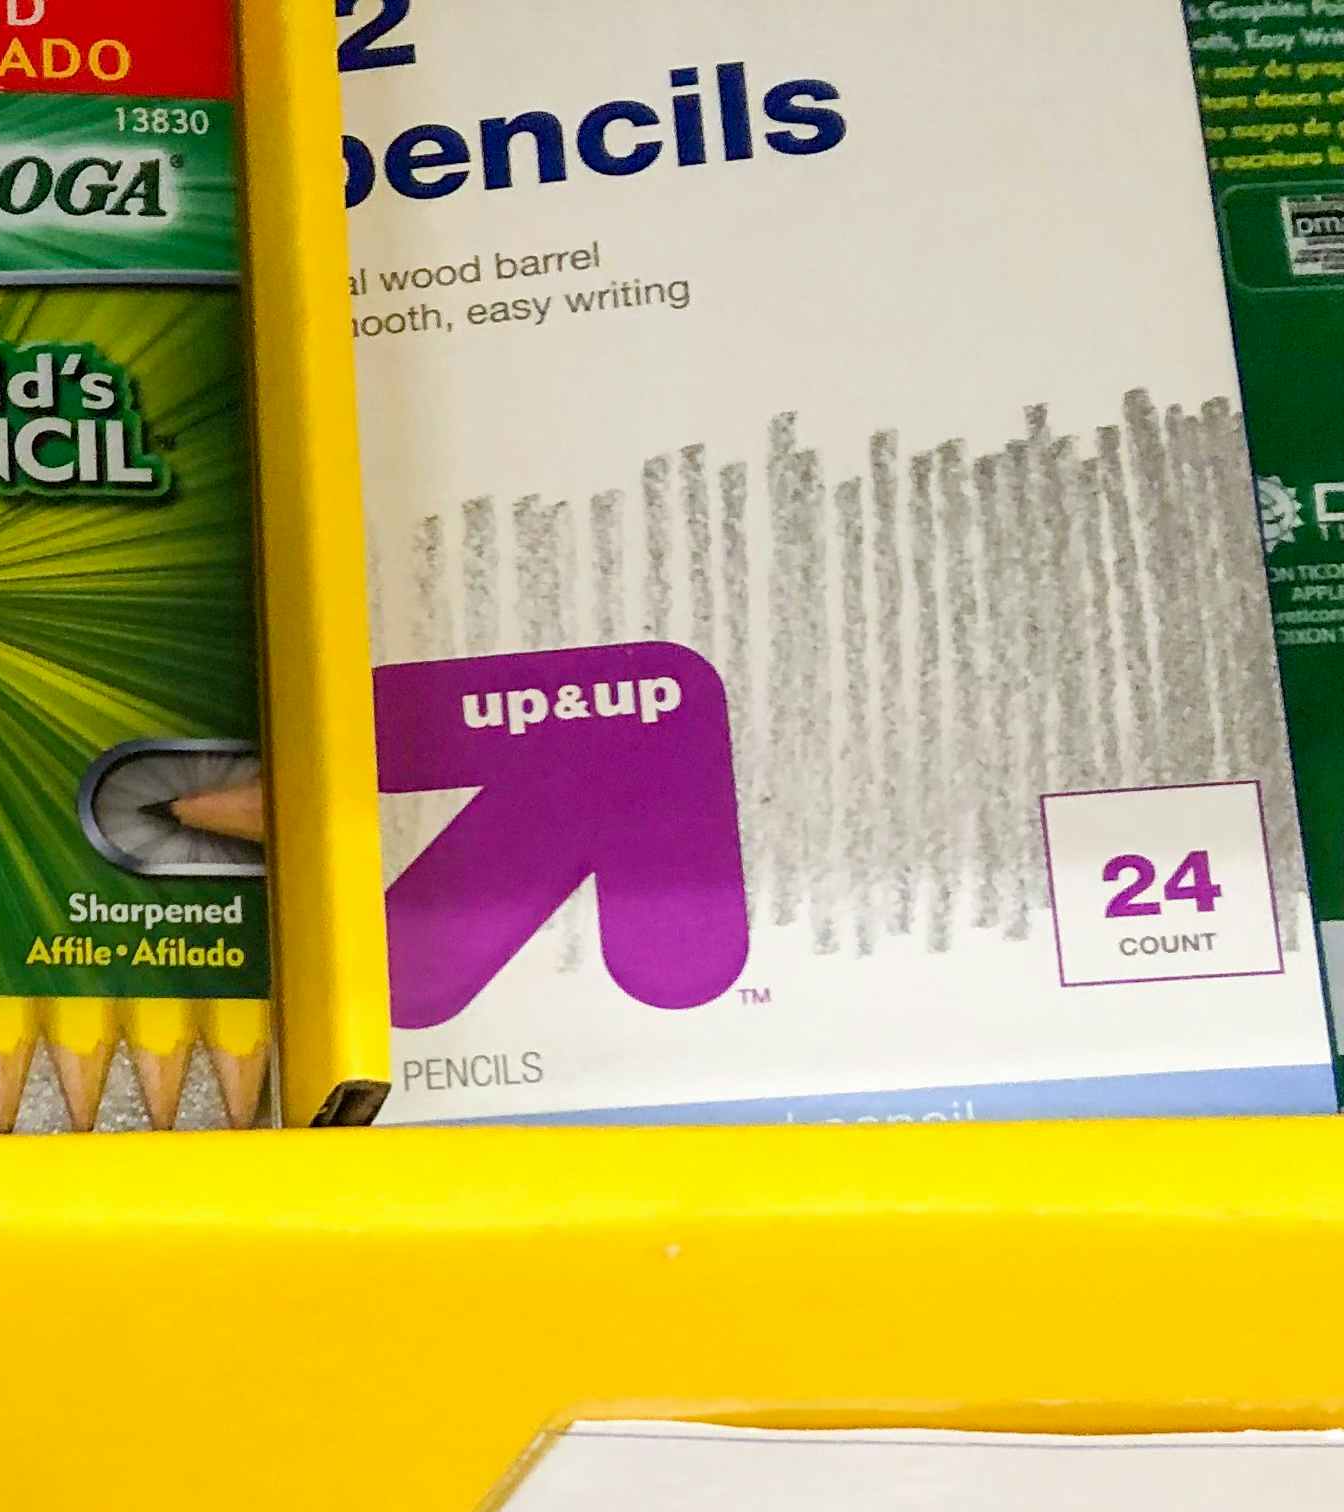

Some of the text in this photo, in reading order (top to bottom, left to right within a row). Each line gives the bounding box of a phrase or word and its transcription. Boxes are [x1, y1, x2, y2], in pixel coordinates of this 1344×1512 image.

[114, 107, 210, 136] 13830
[380, 243, 600, 293] wood barrel
[467, 293, 551, 331] easy
[564, 276, 691, 317] writing
[462, 674, 682, 735] up&up
[1102, 849, 1223, 921] 24
[69, 893, 243, 928] Sharpened
[1120, 931, 1219, 957] COUNT
[403, 1052, 544, 1093] PENCILS
